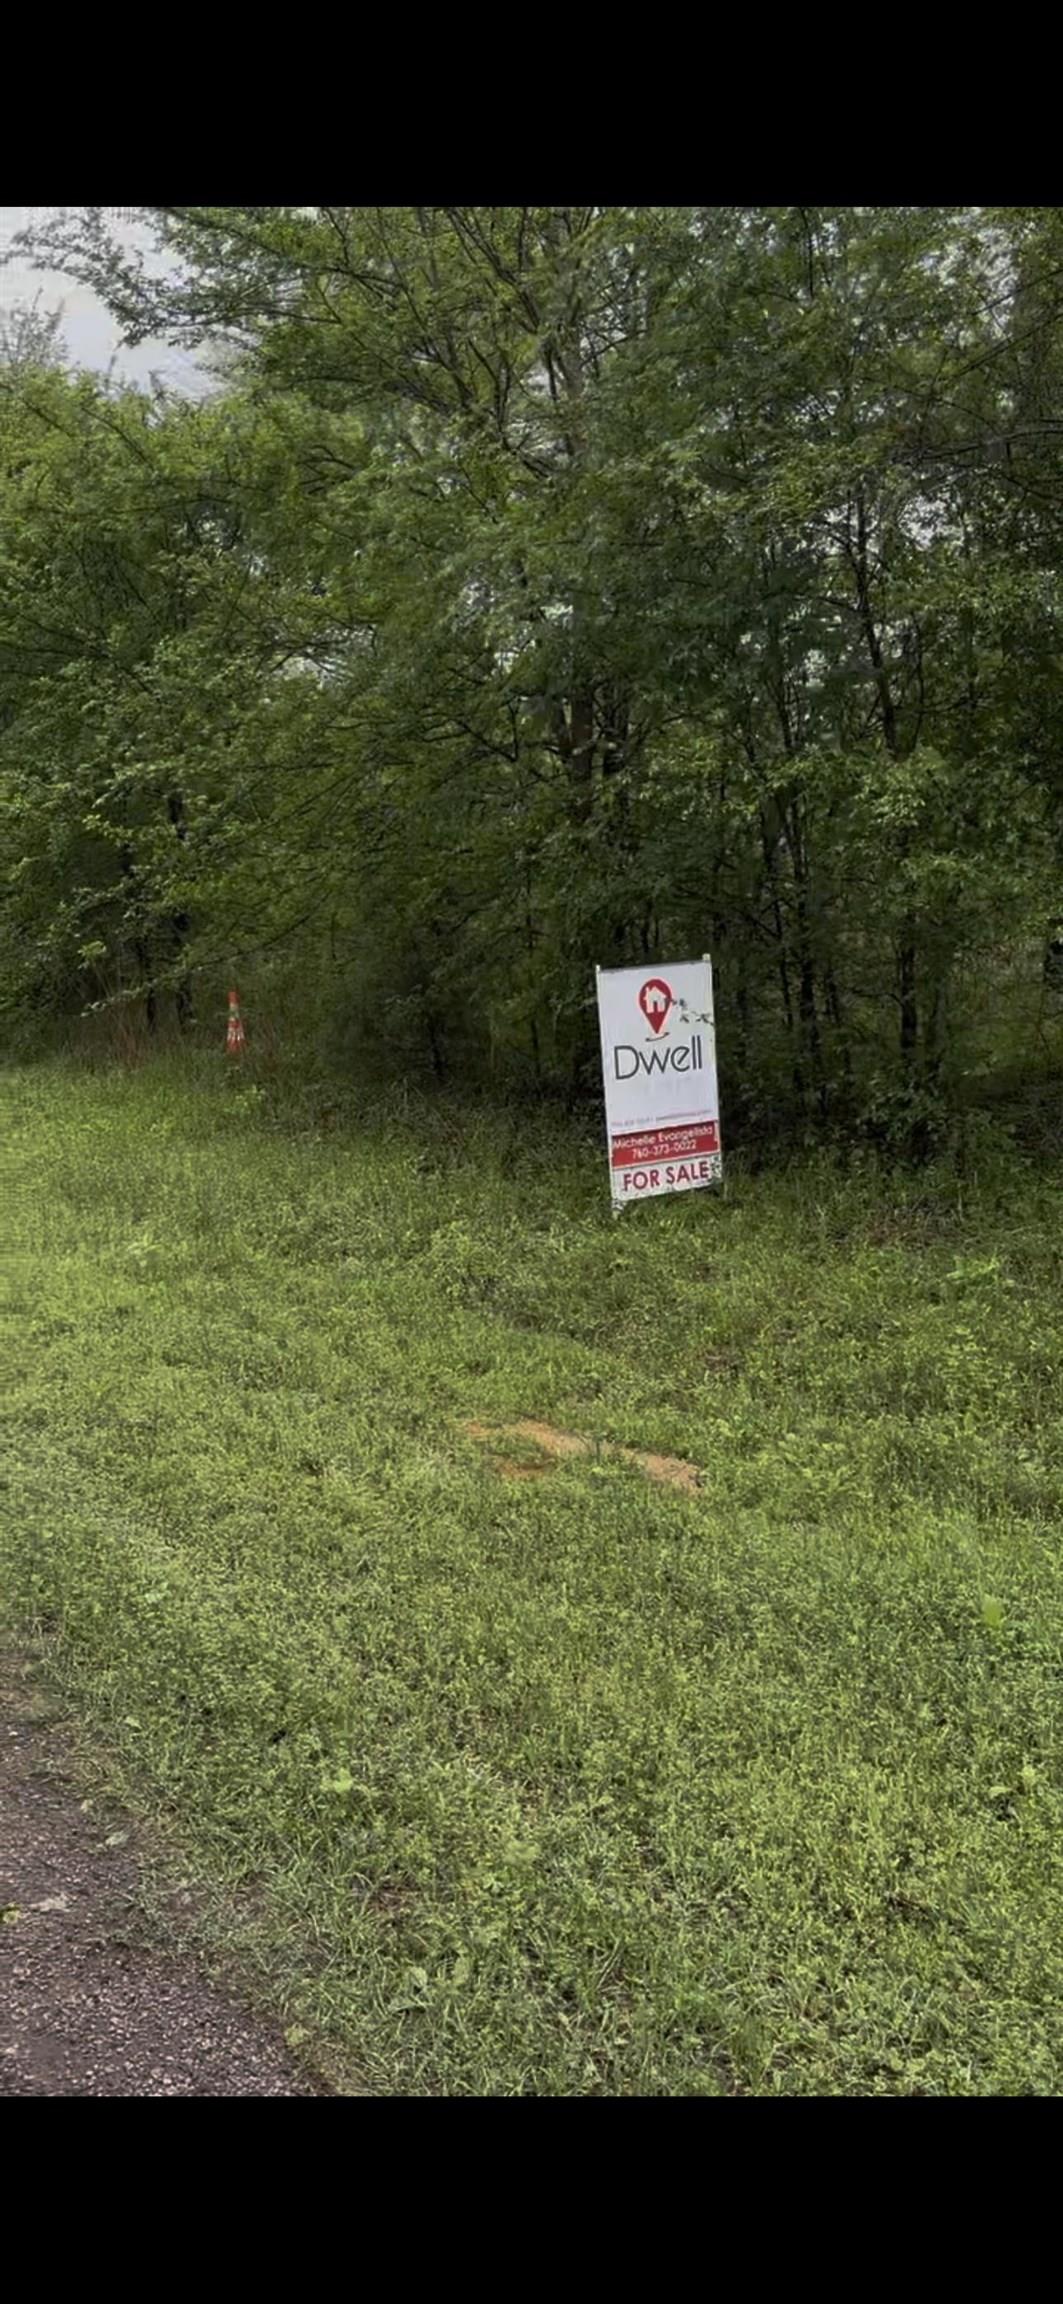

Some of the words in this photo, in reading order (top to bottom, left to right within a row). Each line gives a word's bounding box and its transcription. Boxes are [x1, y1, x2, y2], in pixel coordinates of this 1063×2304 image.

[614, 1035, 702, 1080] Dwell
[613, 1134, 656, 1149] Michelle
[623, 1169, 660, 1191] FOR
[665, 1161, 709, 1184] SALE
